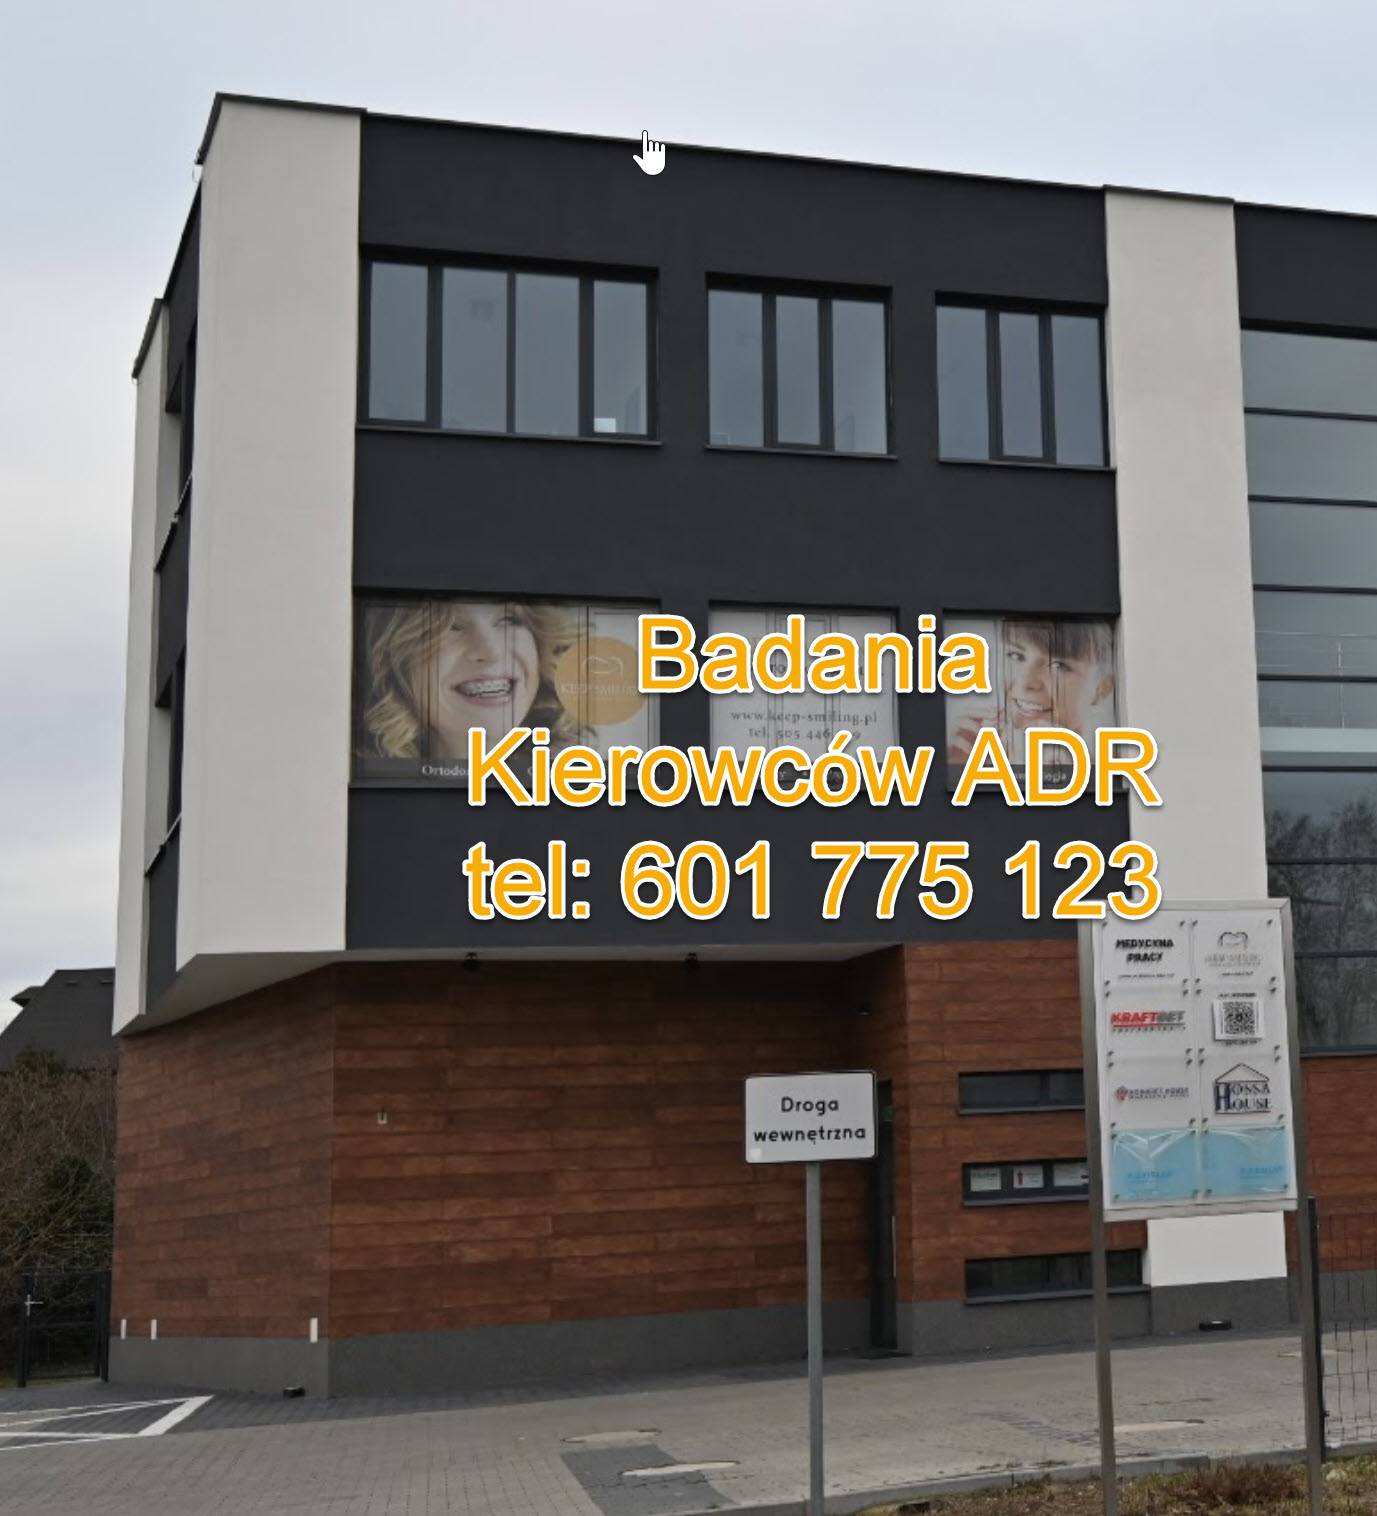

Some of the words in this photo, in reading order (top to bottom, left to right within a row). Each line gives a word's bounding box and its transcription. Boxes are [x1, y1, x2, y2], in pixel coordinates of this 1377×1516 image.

[1115, 938, 1174, 949] MEDYCYNA
[1126, 952, 1164, 963] PRACY
[781, 1096, 839, 1116] Droga
[754, 1126, 866, 1145] wewnętrzna
